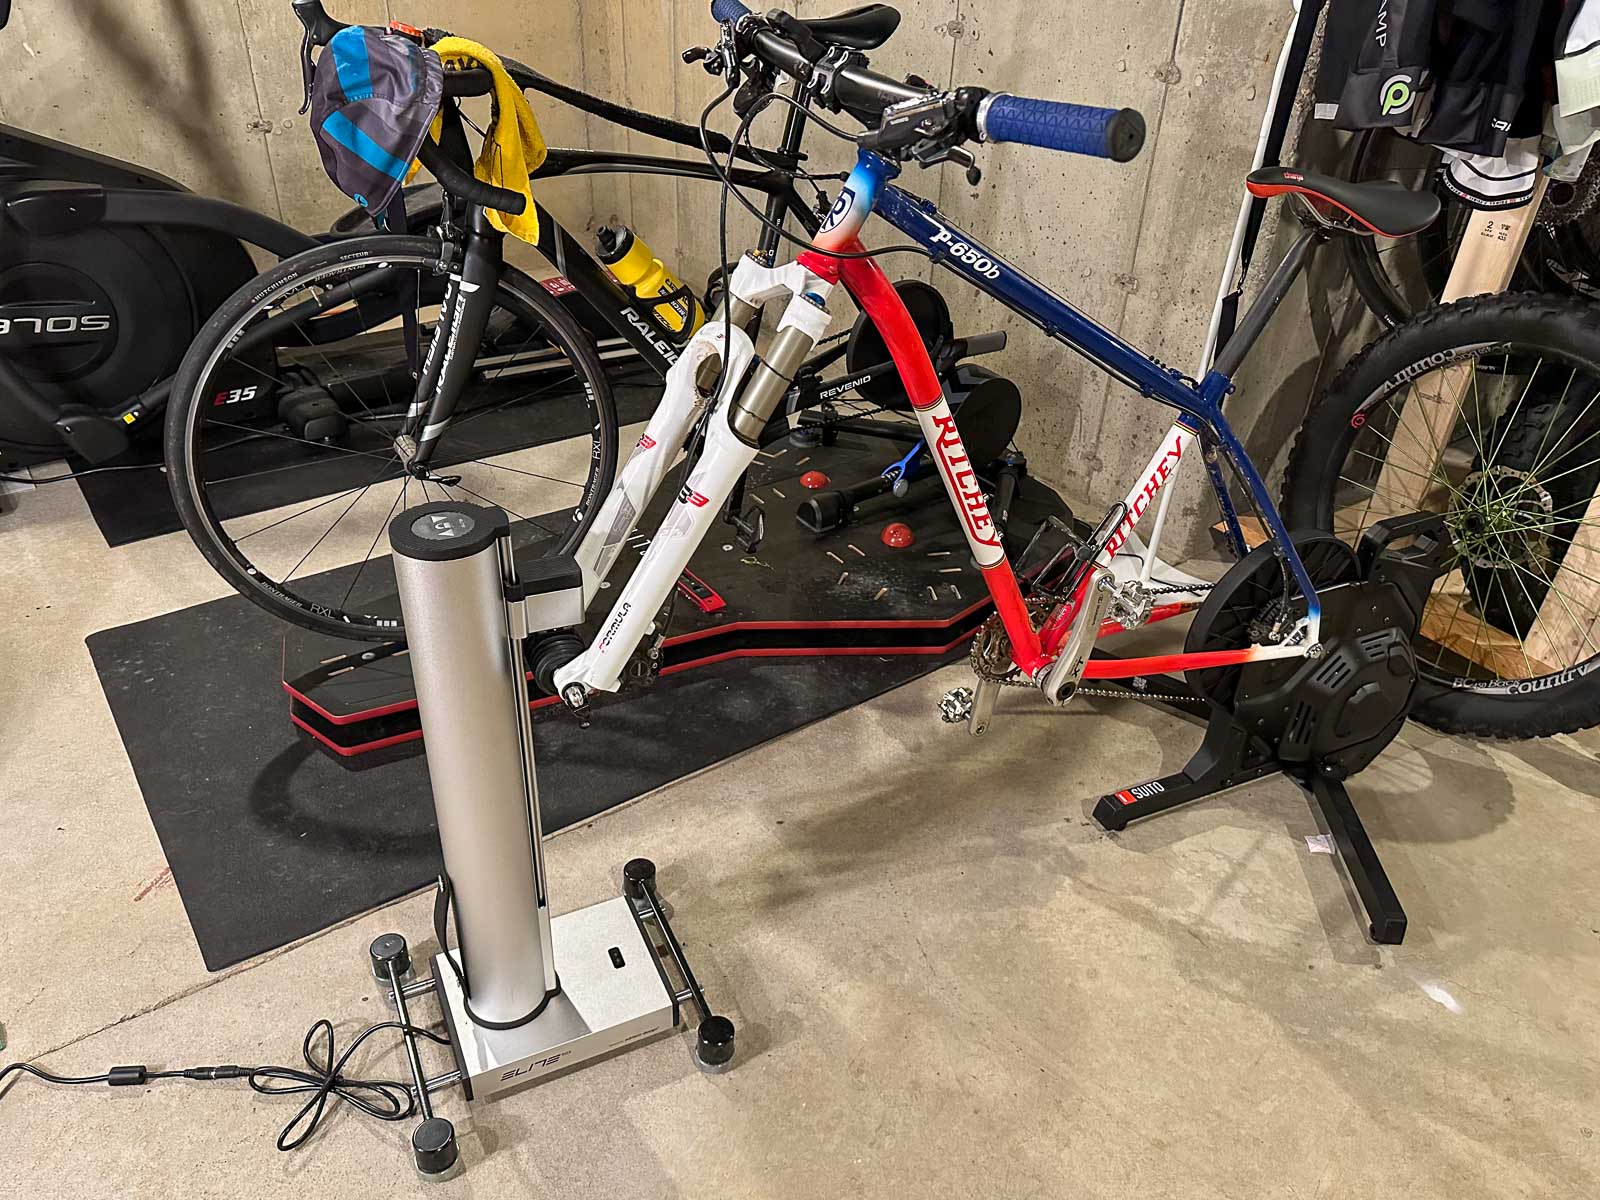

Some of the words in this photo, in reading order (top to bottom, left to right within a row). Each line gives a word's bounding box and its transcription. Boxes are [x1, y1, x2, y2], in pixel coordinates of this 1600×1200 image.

[254, 272, 298, 301] HUTCHINSON
[213, 386, 257, 407] E35
[820, 375, 871, 400] REVENIO
[585, 466, 600, 506] BONTRAGER
[593, 439, 602, 460] RXL
[932, 414, 1001, 546] RITCHEY
[1104, 436, 1182, 558] RITCHEY
[261, 581, 303, 608] BONTRAGER
[310, 603, 336, 620] RXL
[599, 602, 631, 654] FORMULA
[1131, 781, 1165, 800] SUITO
[500, 1054, 561, 1082] ELITE
